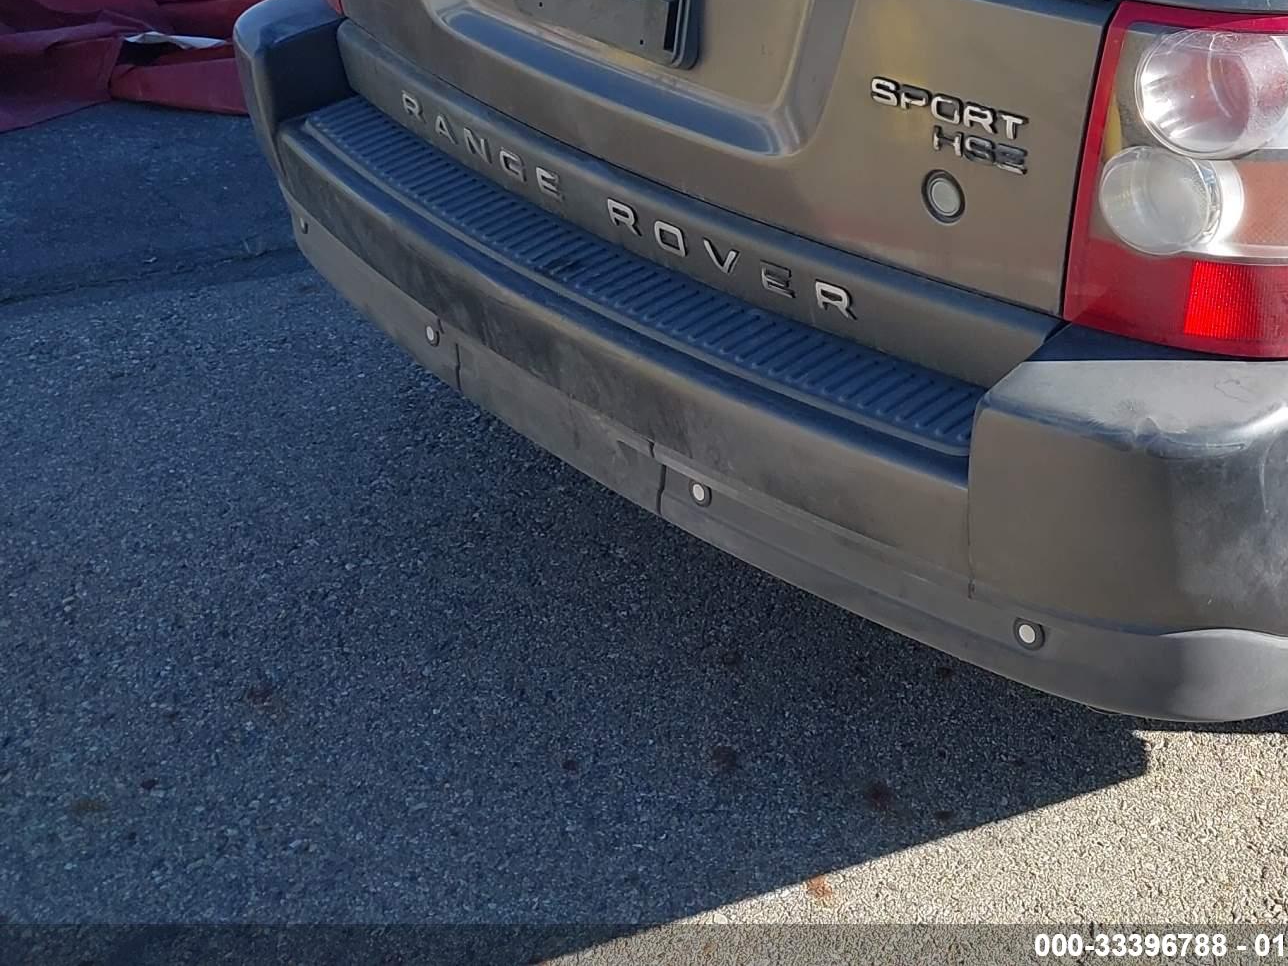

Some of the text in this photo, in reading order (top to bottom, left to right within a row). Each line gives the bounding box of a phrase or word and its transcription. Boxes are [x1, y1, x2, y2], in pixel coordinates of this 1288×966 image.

[870, 76, 1029, 140] SPORT
[932, 124, 1028, 175] HSE
[401, 90, 857, 321] RANGE ROVER
